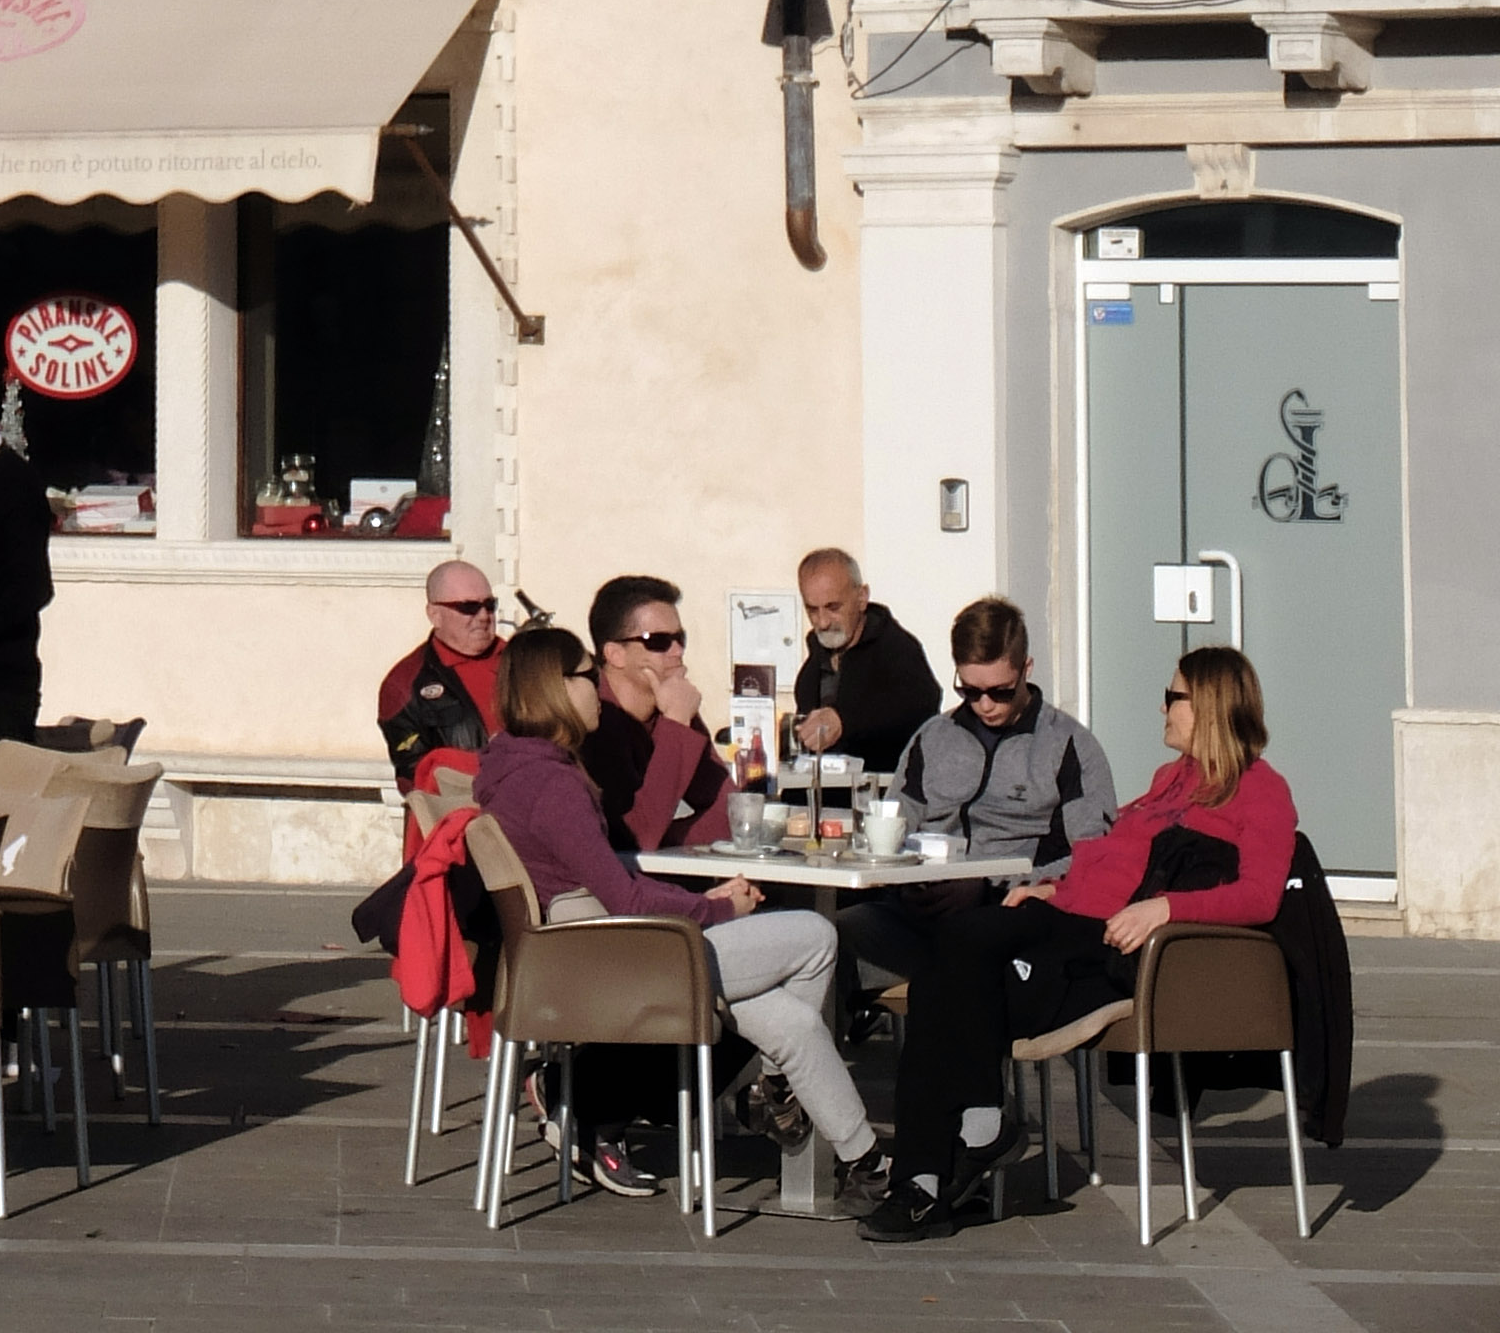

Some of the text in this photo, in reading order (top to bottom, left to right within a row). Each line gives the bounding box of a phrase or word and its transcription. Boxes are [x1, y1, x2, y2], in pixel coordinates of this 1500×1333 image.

[28, 157, 67, 173] non
[87, 153, 153, 178] potuto
[158, 151, 244, 172] ritornare
[249, 148, 265, 170] al
[270, 147, 322, 170] cielo.
[16, 299, 126, 345] PIRANSKE
[28, 352, 114, 388] SOLINE
